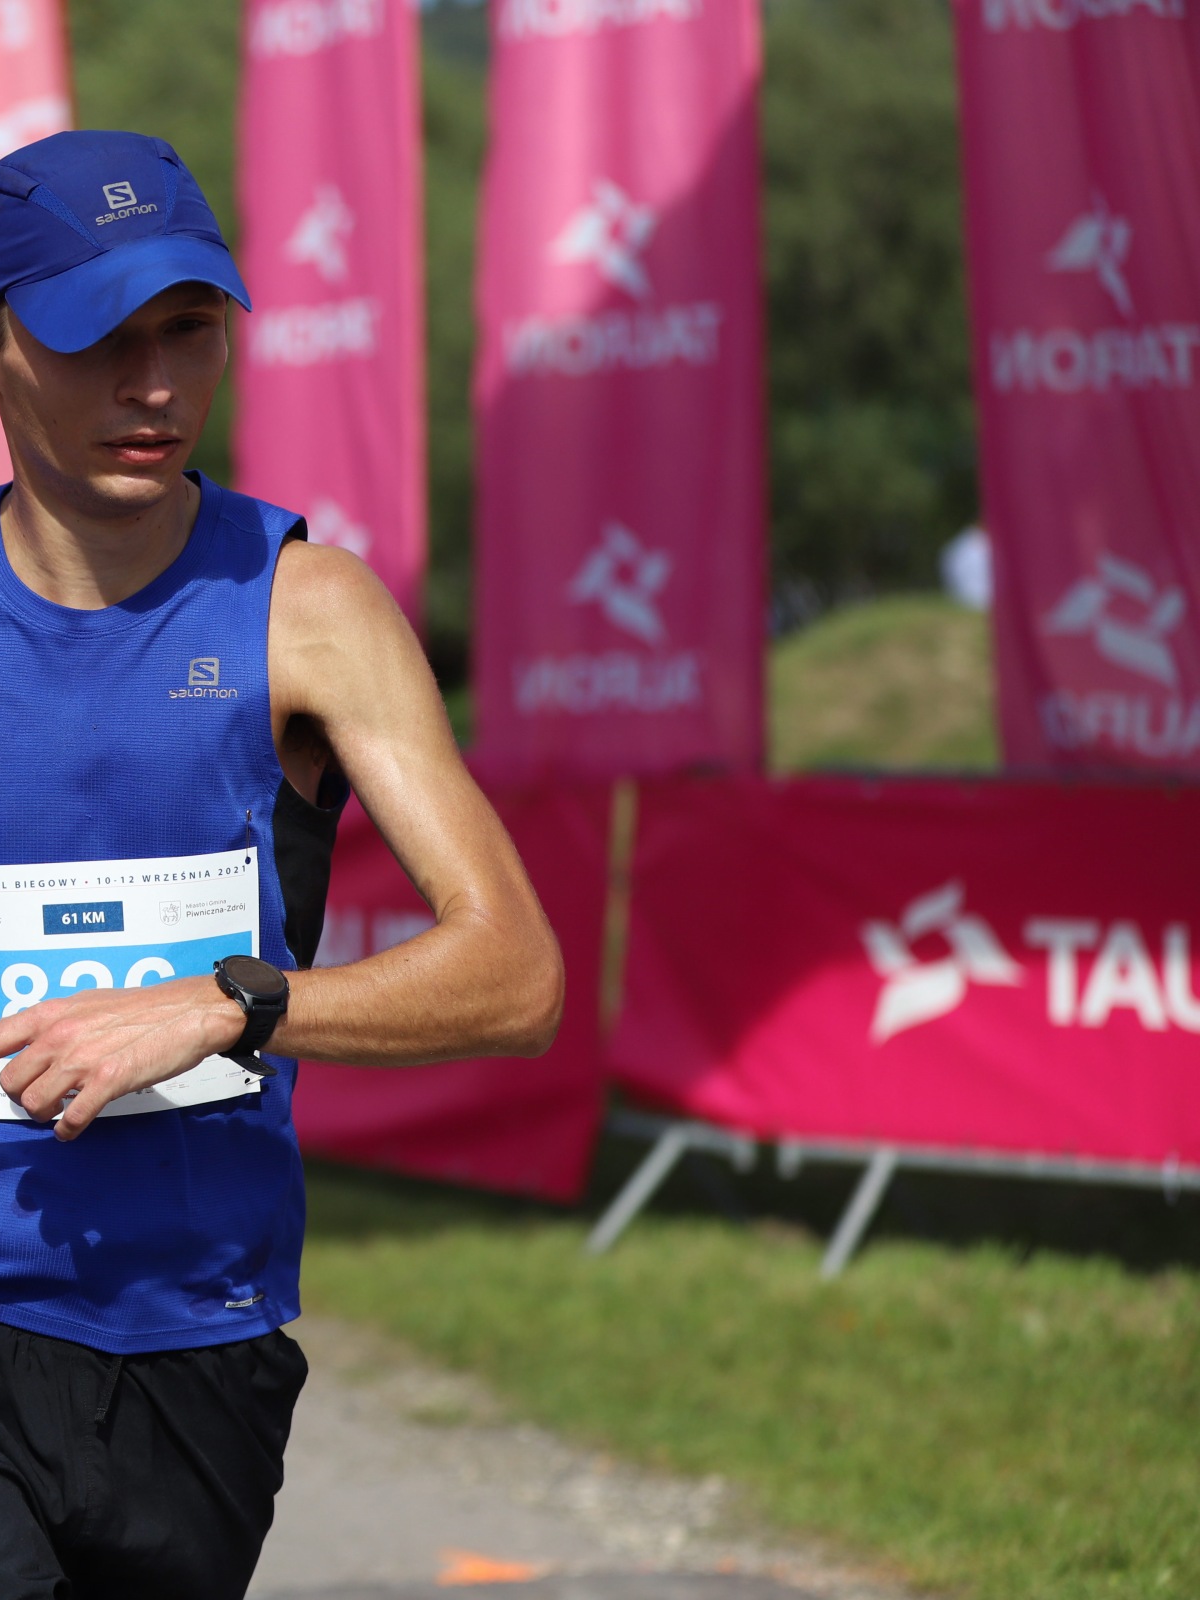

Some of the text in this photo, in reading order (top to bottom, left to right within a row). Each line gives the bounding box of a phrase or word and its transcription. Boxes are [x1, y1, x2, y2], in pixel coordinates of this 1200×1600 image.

[15, 878, 77, 889] BIEGOWY
[97, 876, 135, 885] 10-12
[142, 870, 211, 883] WRZEŚNIA
[218, 865, 246, 876] 2021
[61, 911, 105, 925] 61 KM
[186, 903, 246, 918] Piwniczna-Zdrój
[1023, 916, 1200, 1033] TAU
